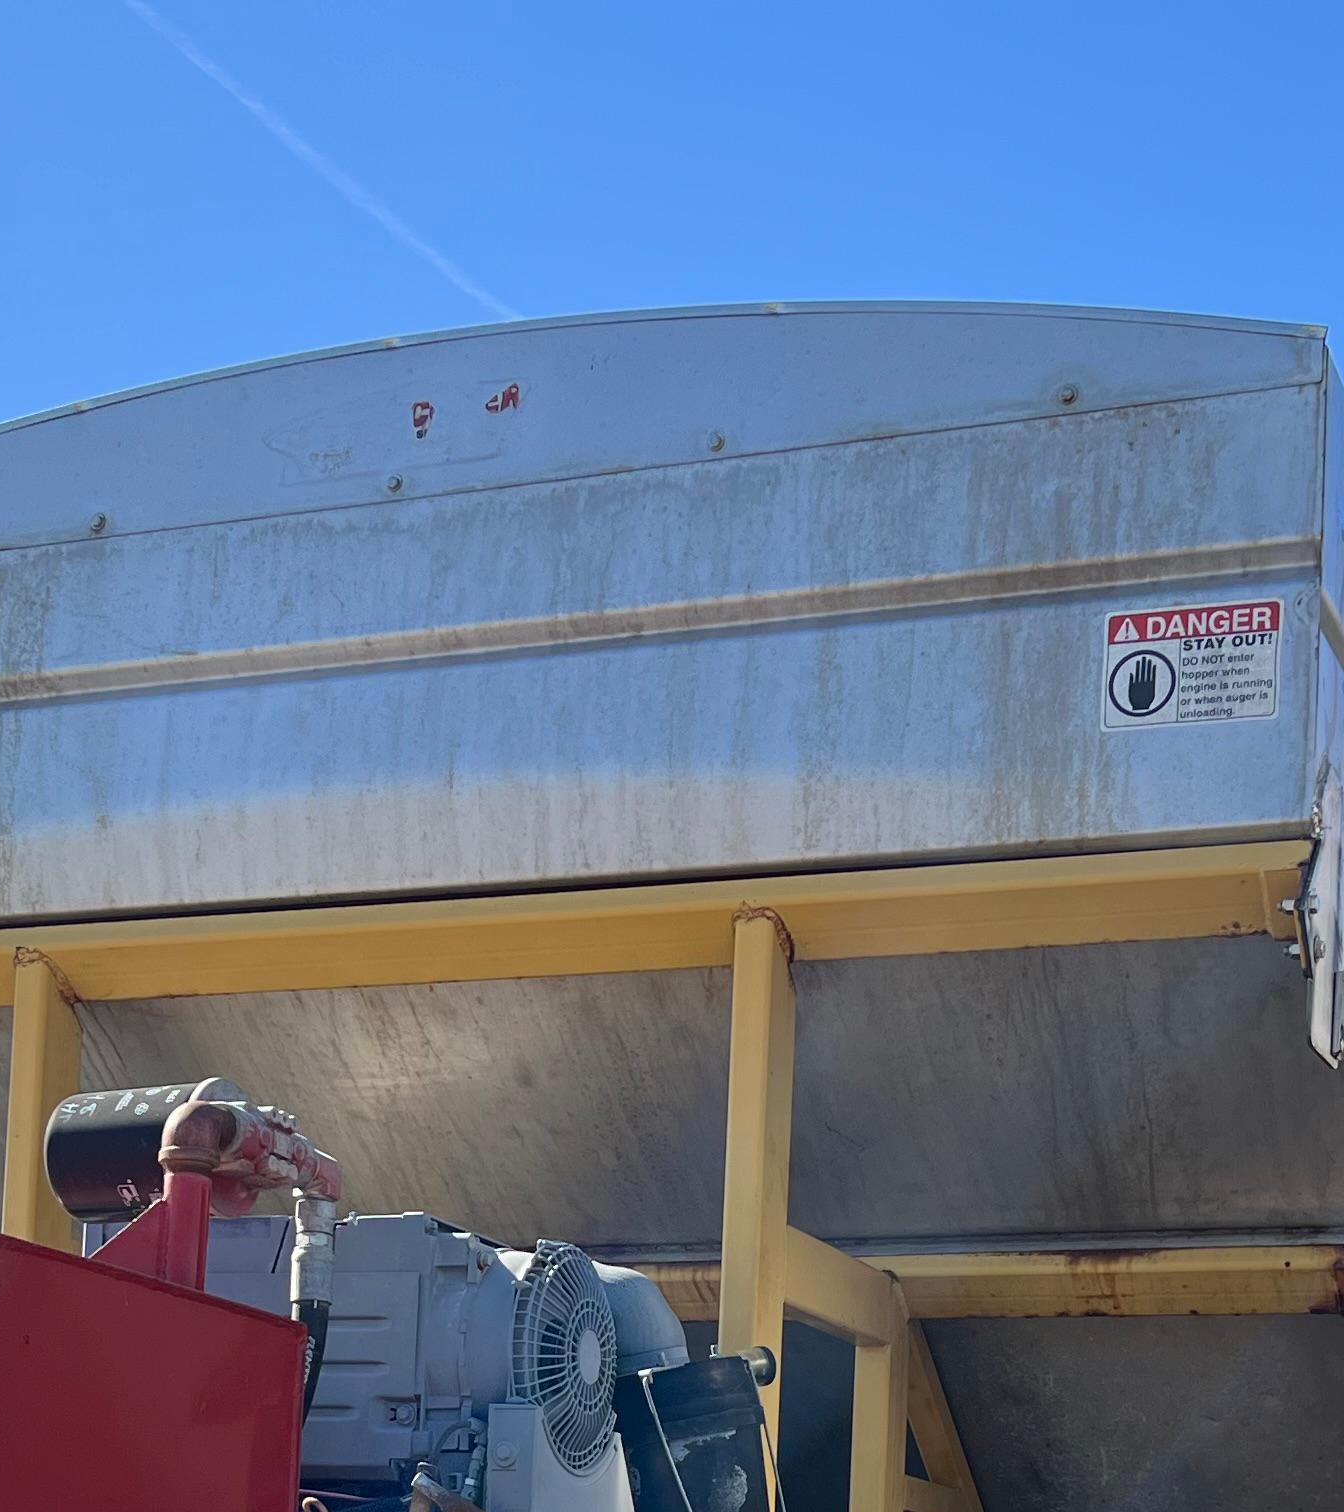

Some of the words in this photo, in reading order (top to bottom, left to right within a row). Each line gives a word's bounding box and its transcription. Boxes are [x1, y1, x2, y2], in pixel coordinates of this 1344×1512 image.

[1146, 607, 1272, 640] DANGER
[1183, 637, 1226, 651] STAY
[1232, 633, 1273, 647] OUT!
[1182, 656, 1198, 667] DO
[1201, 654, 1224, 665] NOT
[1227, 653, 1255, 663] enter
[1181, 669, 1219, 680] hopper
[1222, 667, 1250, 677] when
[1180, 682, 1217, 694] engine
[1219, 680, 1229, 690] is
[1231, 678, 1273, 689] running
[1180, 698, 1191, 706] or
[1194, 695, 1223, 705] when
[1225, 692, 1256, 703] auger
[1259, 690, 1268, 700] is
